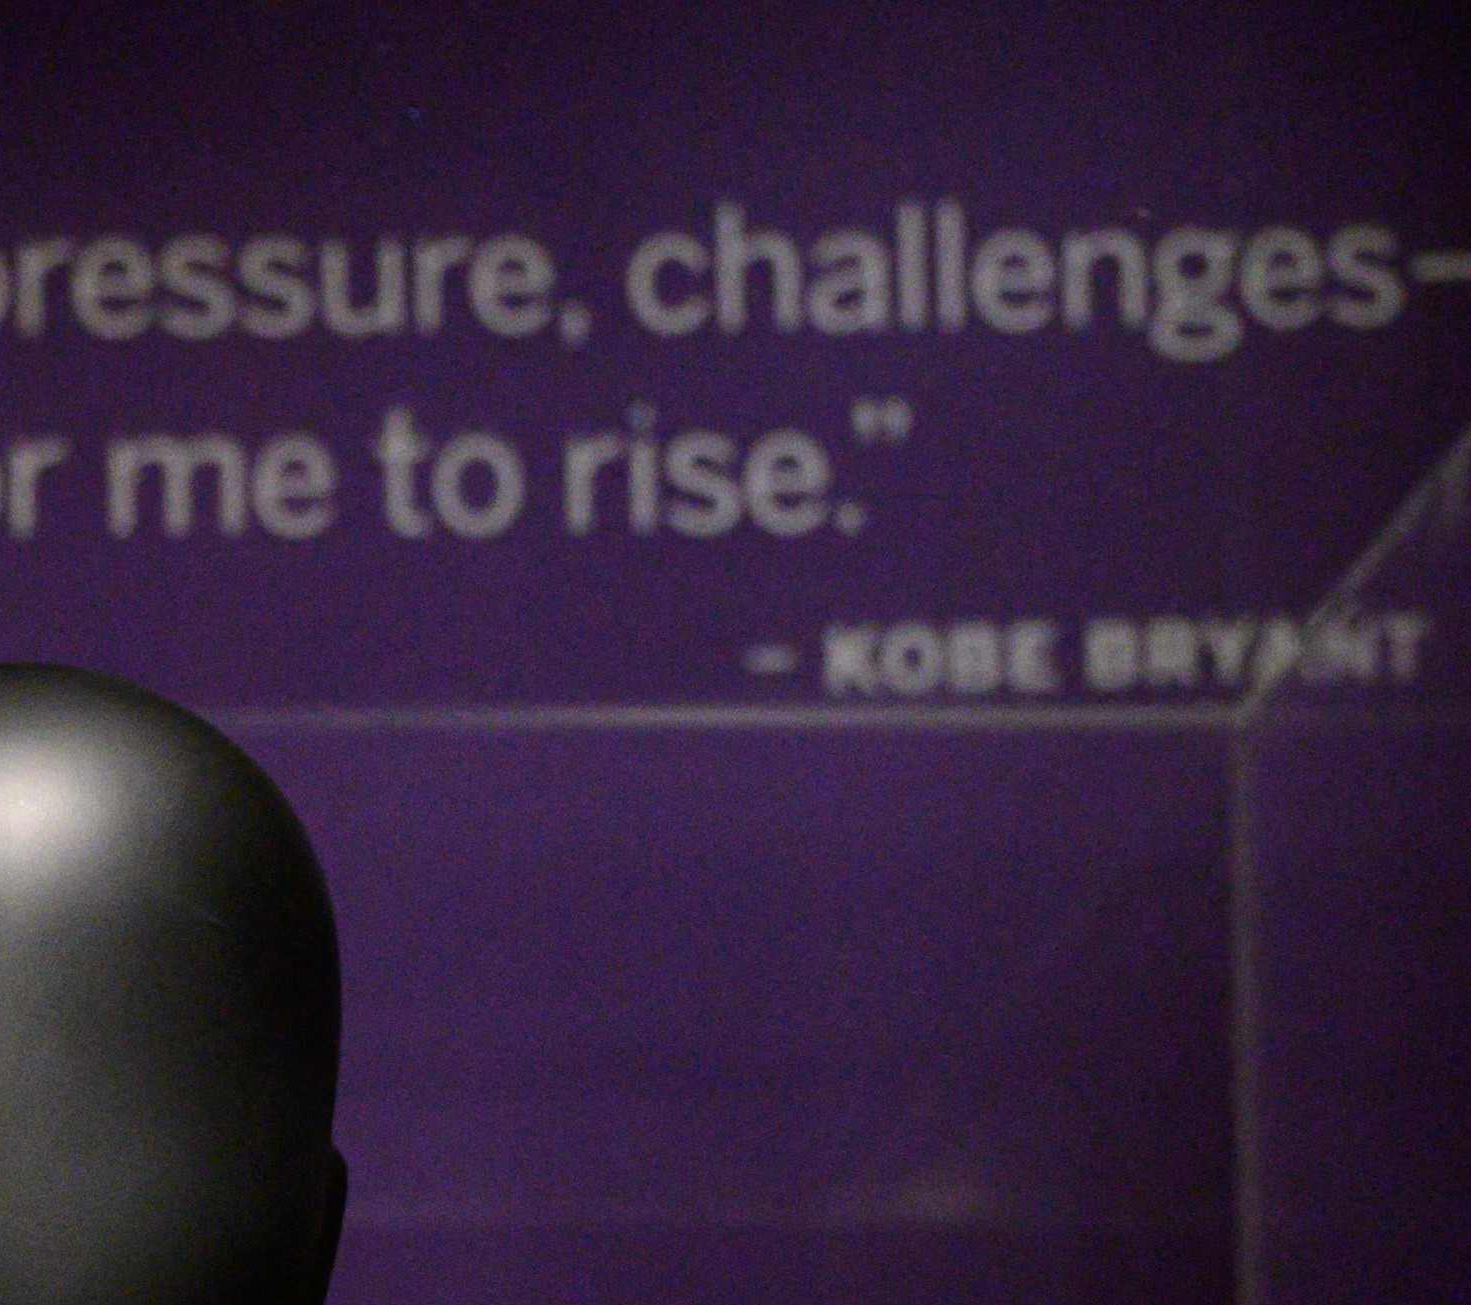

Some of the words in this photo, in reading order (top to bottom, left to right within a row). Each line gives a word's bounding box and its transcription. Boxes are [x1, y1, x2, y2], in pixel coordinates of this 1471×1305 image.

[105, 428, 339, 540] me
[373, 404, 525, 540] to
[823, 616, 1059, 700] KOBE
[1081, 608, 1429, 694] BRYANT
